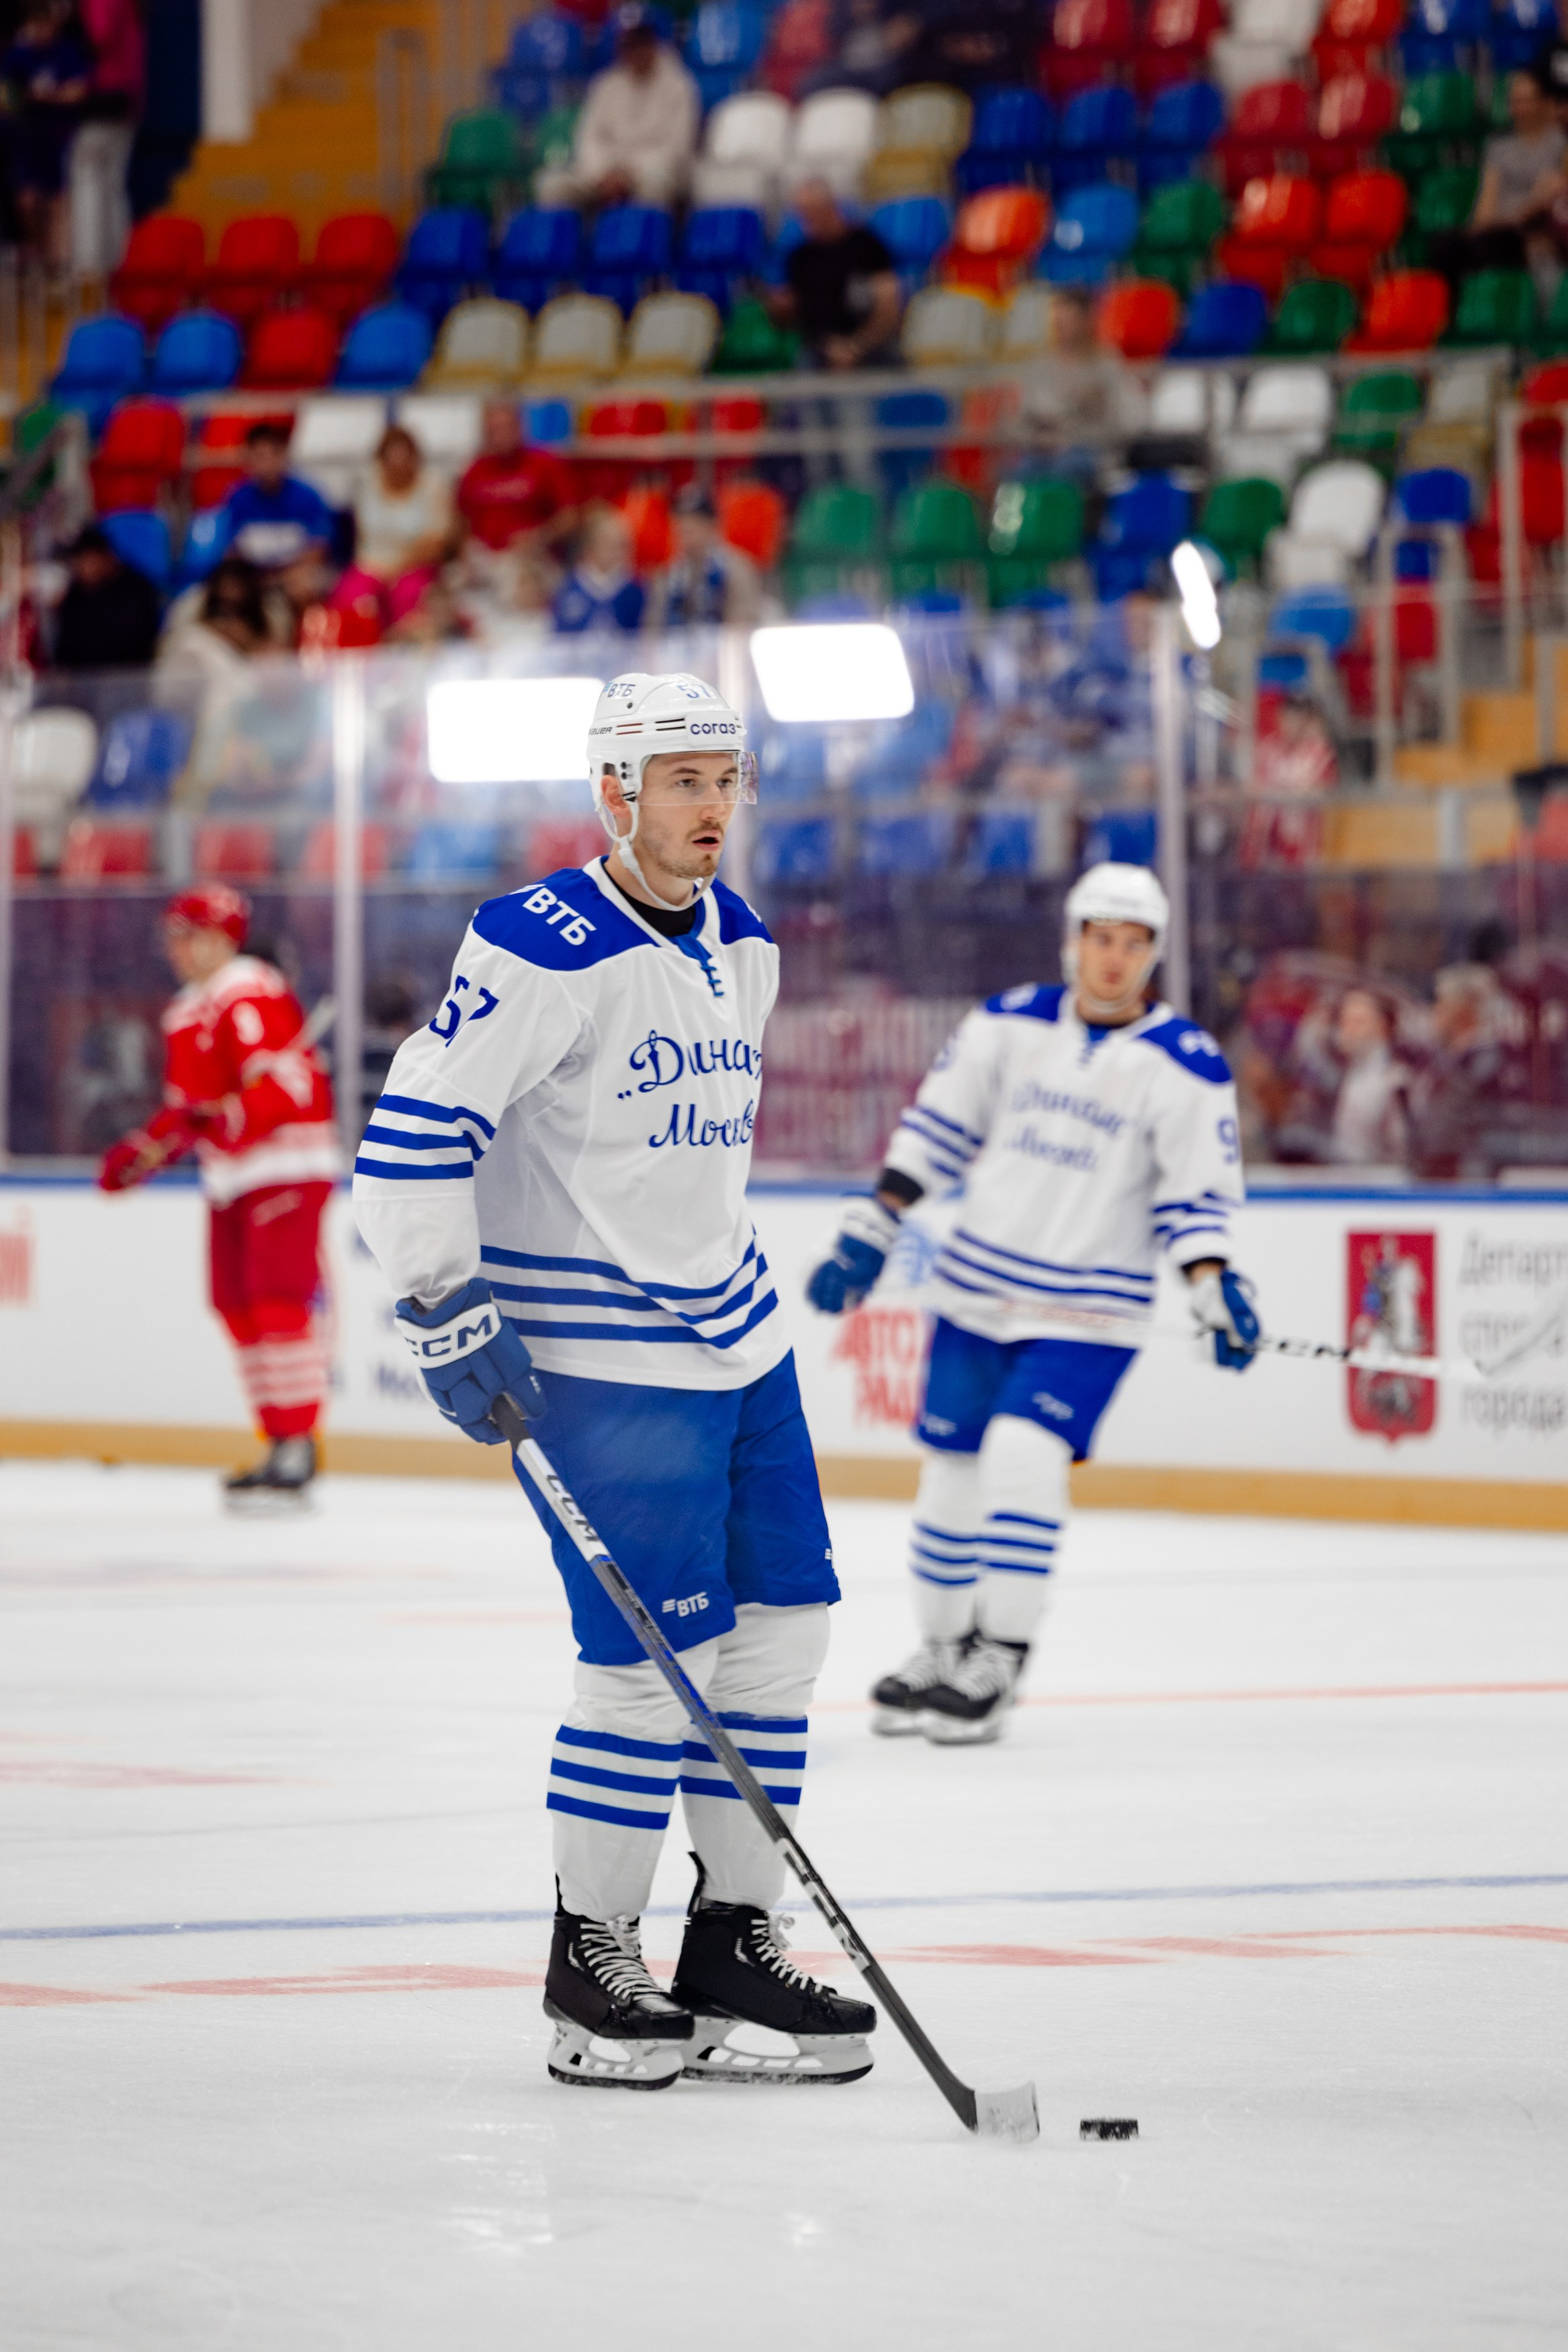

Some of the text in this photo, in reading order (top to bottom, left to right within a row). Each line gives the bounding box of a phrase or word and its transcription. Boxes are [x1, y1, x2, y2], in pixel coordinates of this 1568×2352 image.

[589, 726, 613, 735] AUER
[522, 887, 597, 946] ВТБ
[429, 974, 500, 1048] 57
[677, 1591, 709, 1618] ВТБ
